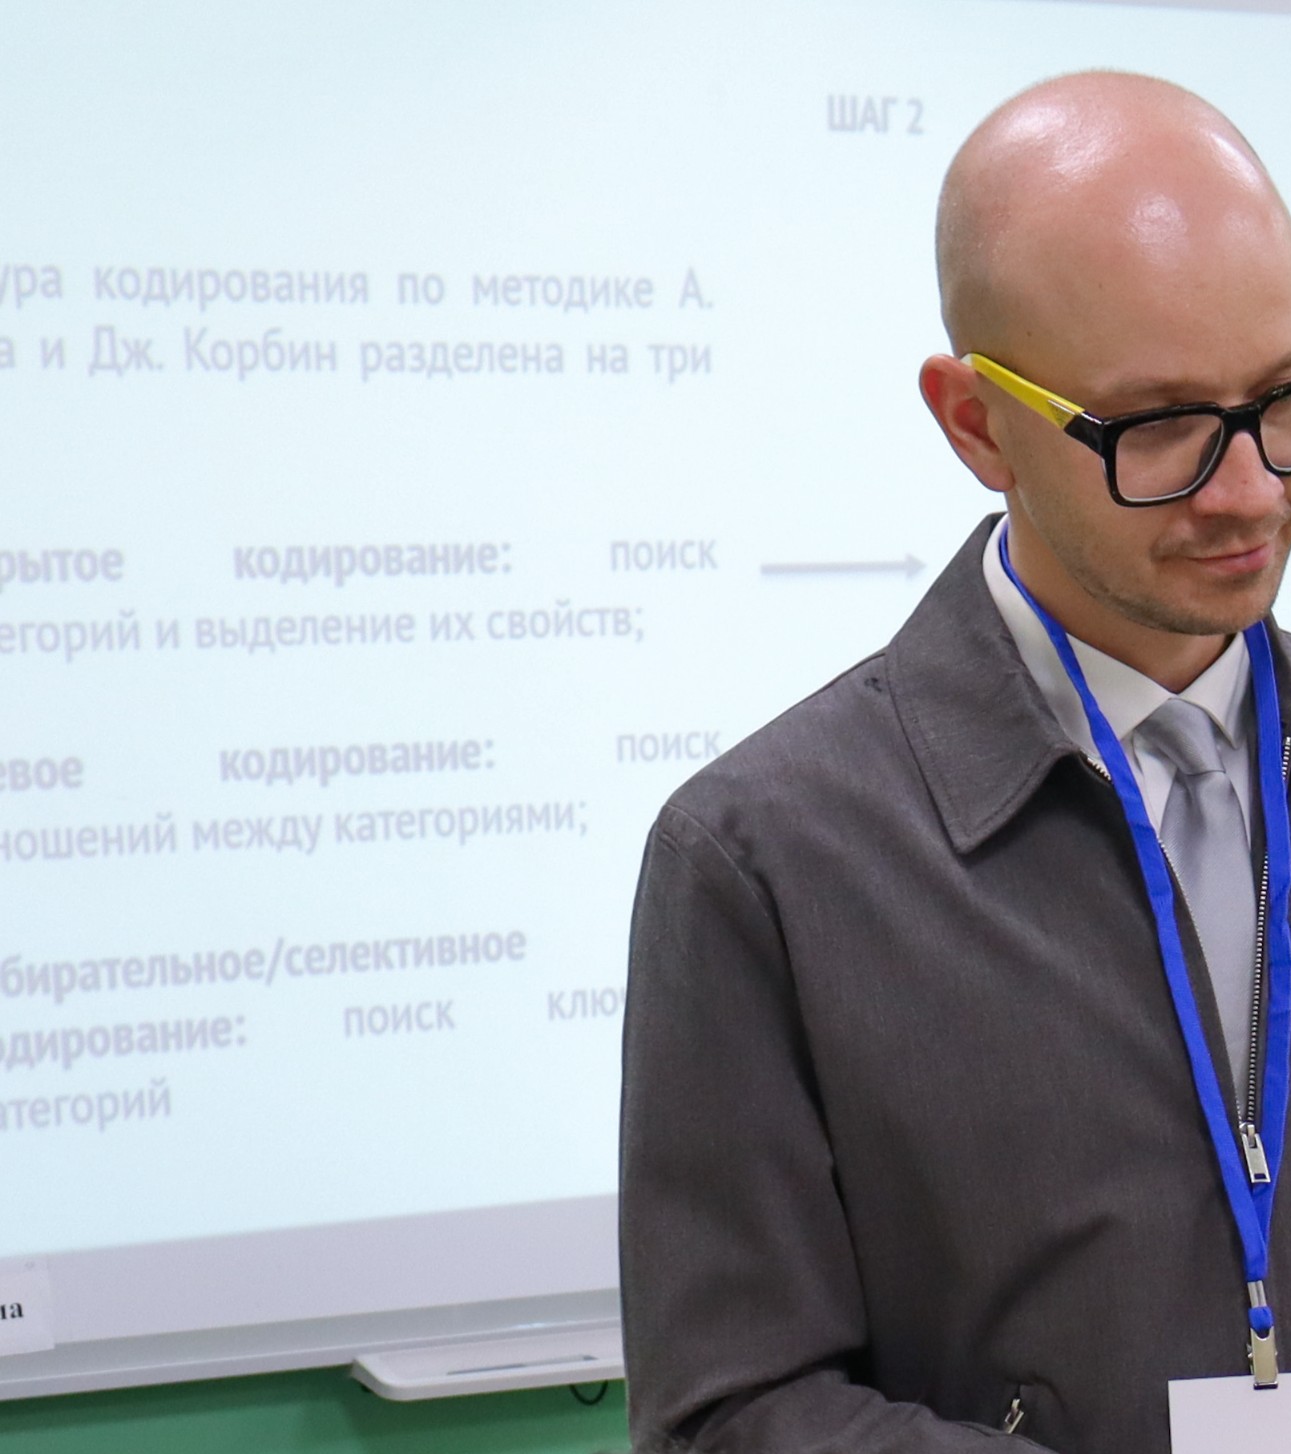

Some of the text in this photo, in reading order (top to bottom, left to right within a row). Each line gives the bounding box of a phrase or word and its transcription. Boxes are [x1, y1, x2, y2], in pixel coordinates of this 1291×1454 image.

[827, 94, 924, 135] ШАГ 2
[94, 266, 369, 312] кодирования
[398, 272, 446, 305] по
[472, 274, 654, 313] методике
[679, 267, 713, 309] А.
[40, 338, 65, 369] и
[88, 324, 164, 377] Дж.
[184, 326, 337, 381] Корбин
[360, 340, 564, 383] разделена
[587, 344, 629, 374] на
[648, 343, 711, 384] три
[234, 543, 511, 588] кодирование:
[610, 540, 717, 571] поиск
[156, 620, 180, 649] и
[195, 613, 416, 654] выделение
[430, 612, 475, 641] их
[486, 599, 644, 642] свойств;
[220, 740, 494, 788] кодирование:
[615, 729, 721, 763] поиск
[192, 815, 323, 855] между
[334, 802, 587, 846] категориями;
[0, 1016, 246, 1070] дирование:
[344, 1000, 455, 1037] поиск
